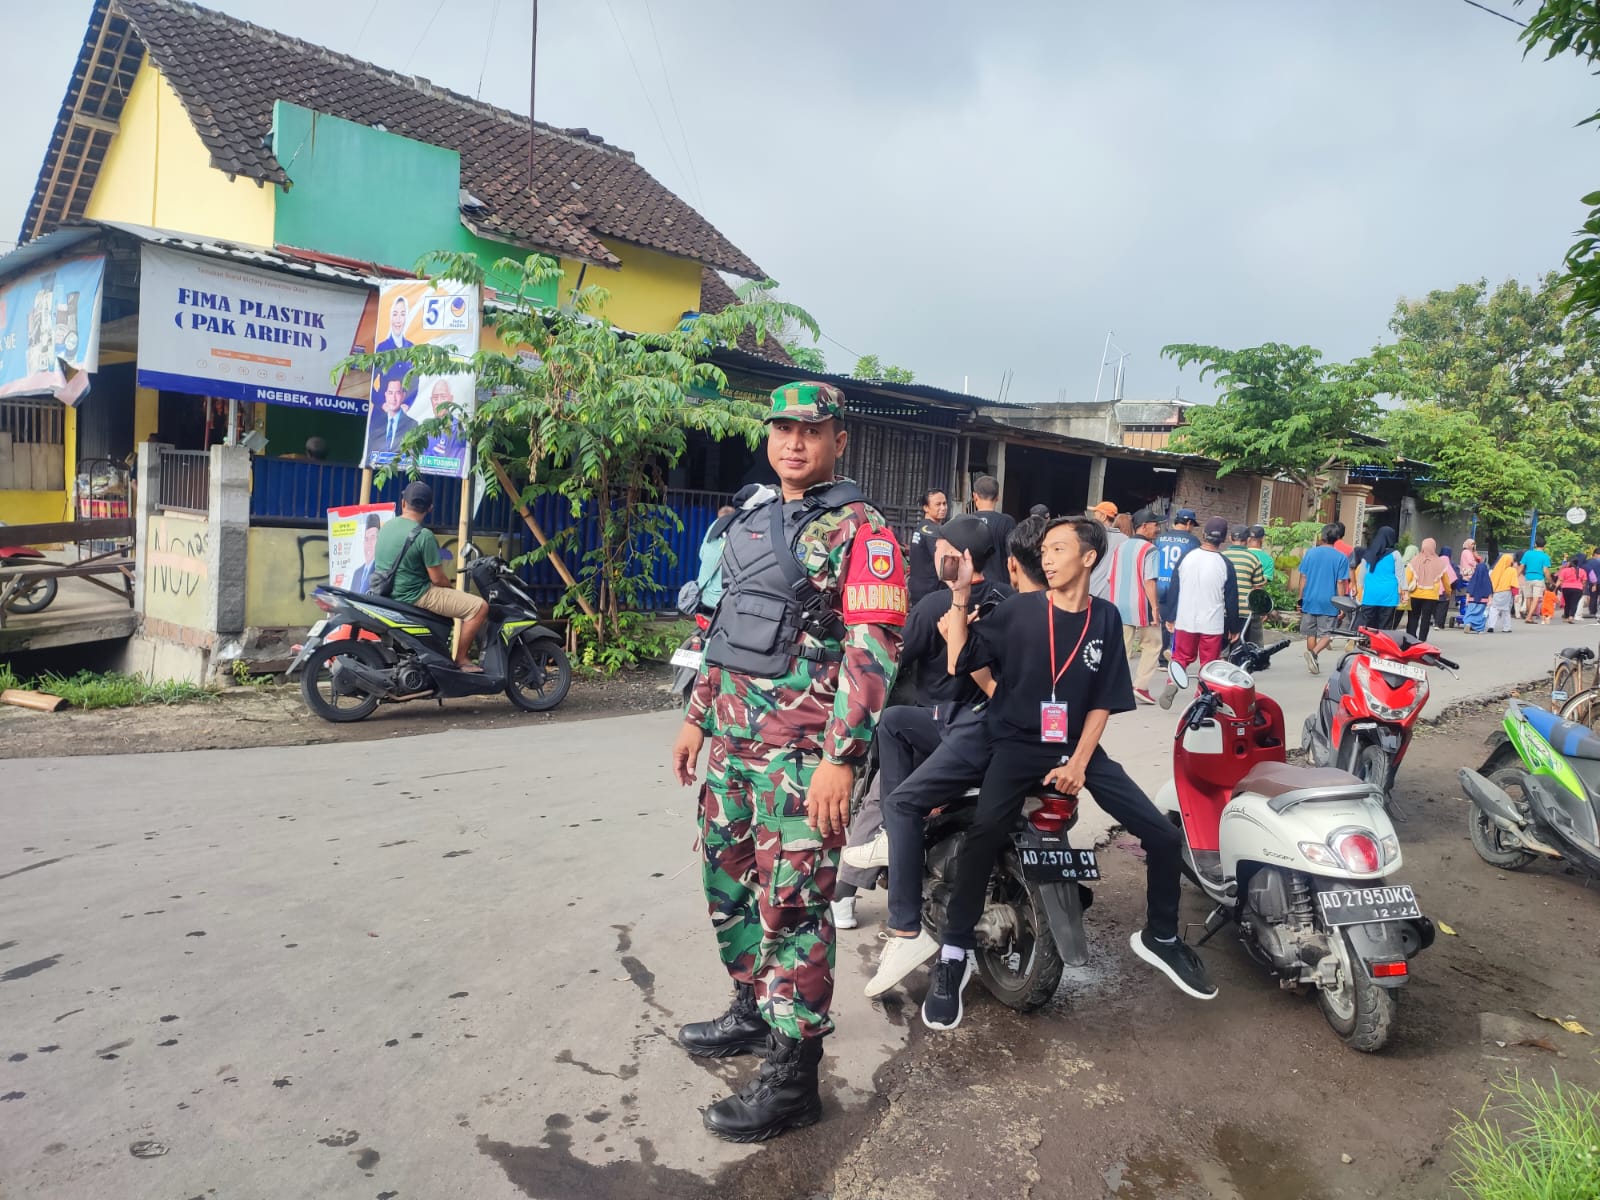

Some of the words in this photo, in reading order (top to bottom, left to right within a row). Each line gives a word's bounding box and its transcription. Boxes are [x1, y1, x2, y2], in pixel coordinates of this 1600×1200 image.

[178, 287, 231, 313] FIMA
[239, 299, 326, 330] PLASTIK
[426, 299, 439, 326] 5
[191, 313, 236, 336] PAK
[244, 328, 313, 350] ARIFIN
[256, 389, 312, 407] NGEBEK,
[315, 396, 359, 413] KUJON,
[1162, 544, 1182, 570] 19
[847, 584, 907, 614] BABINSA
[1023, 850, 1039, 865] AD
[1040, 850, 1073, 866] 2570
[1080, 851, 1095, 866] CV
[1322, 893, 1341, 909] AD
